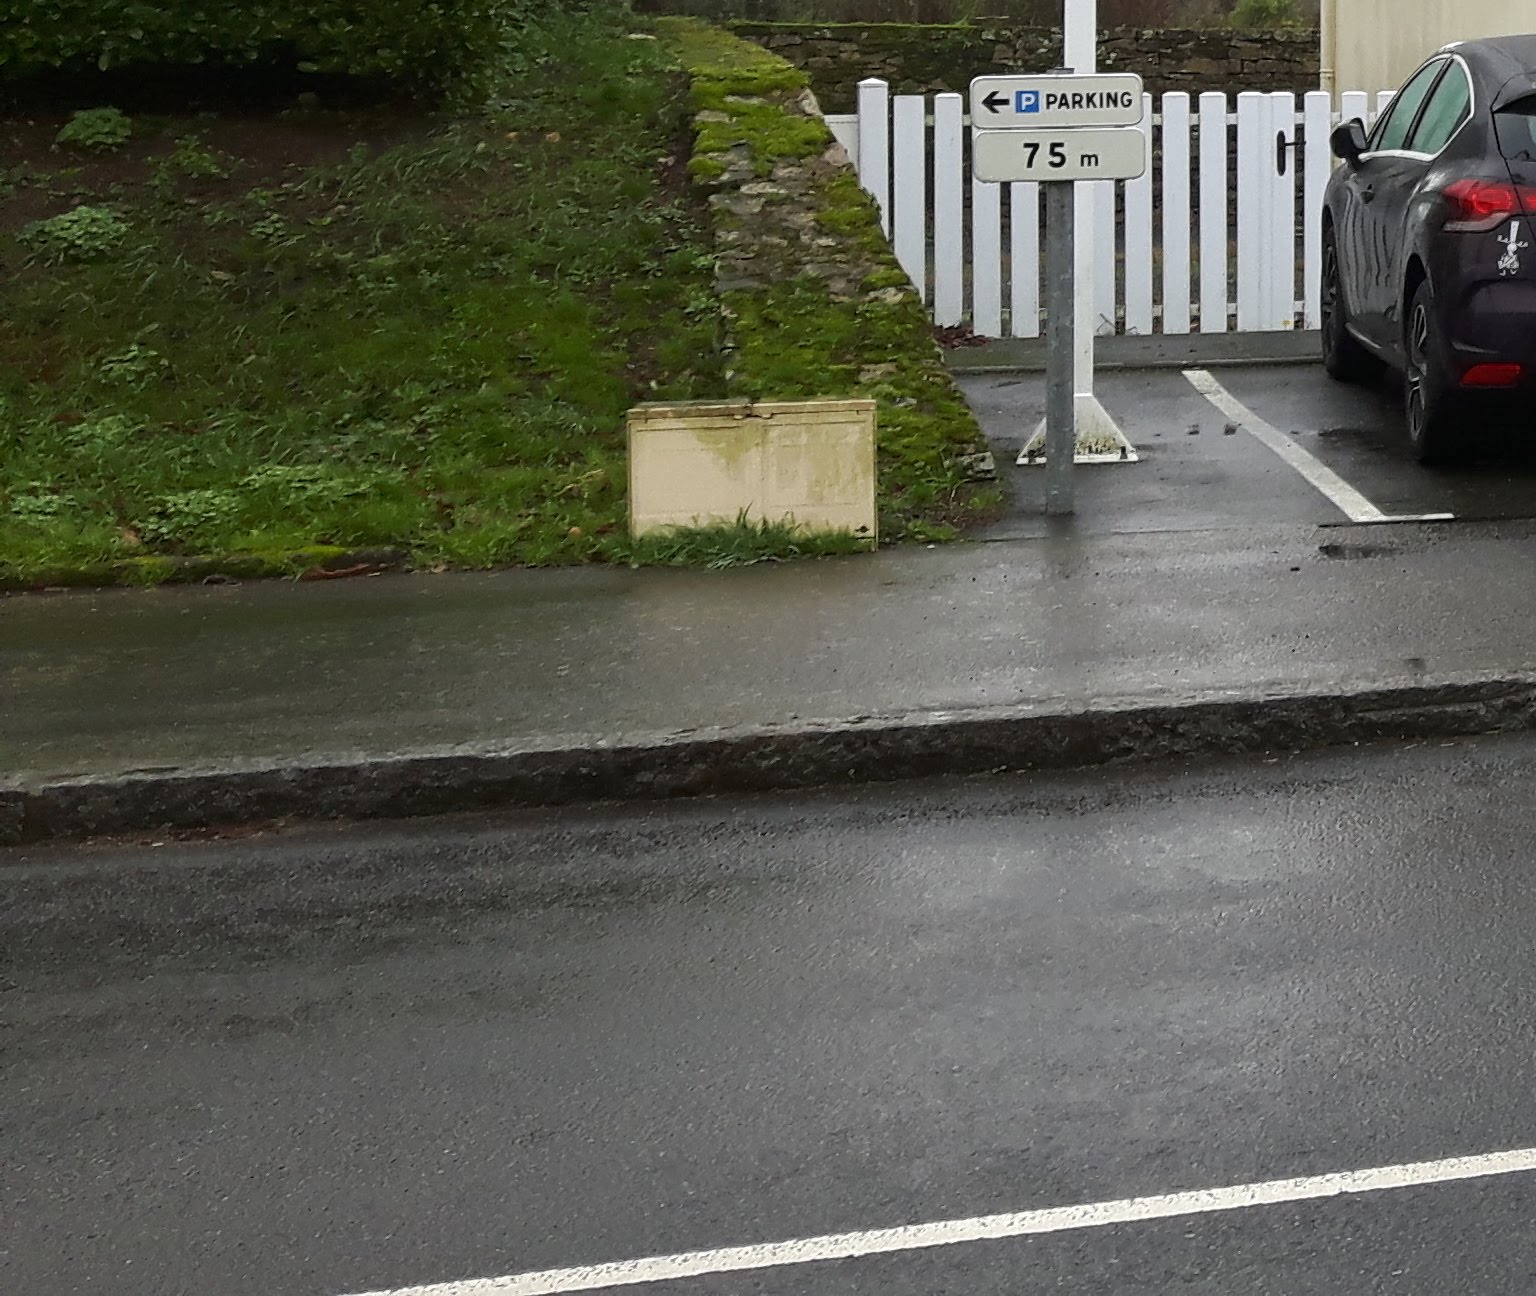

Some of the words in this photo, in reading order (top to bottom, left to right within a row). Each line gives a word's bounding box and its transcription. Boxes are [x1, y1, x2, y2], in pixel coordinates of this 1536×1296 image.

[1045, 91, 1133, 110] PARKING
[1023, 142, 1067, 169] 75
[1080, 153, 1099, 168] m
